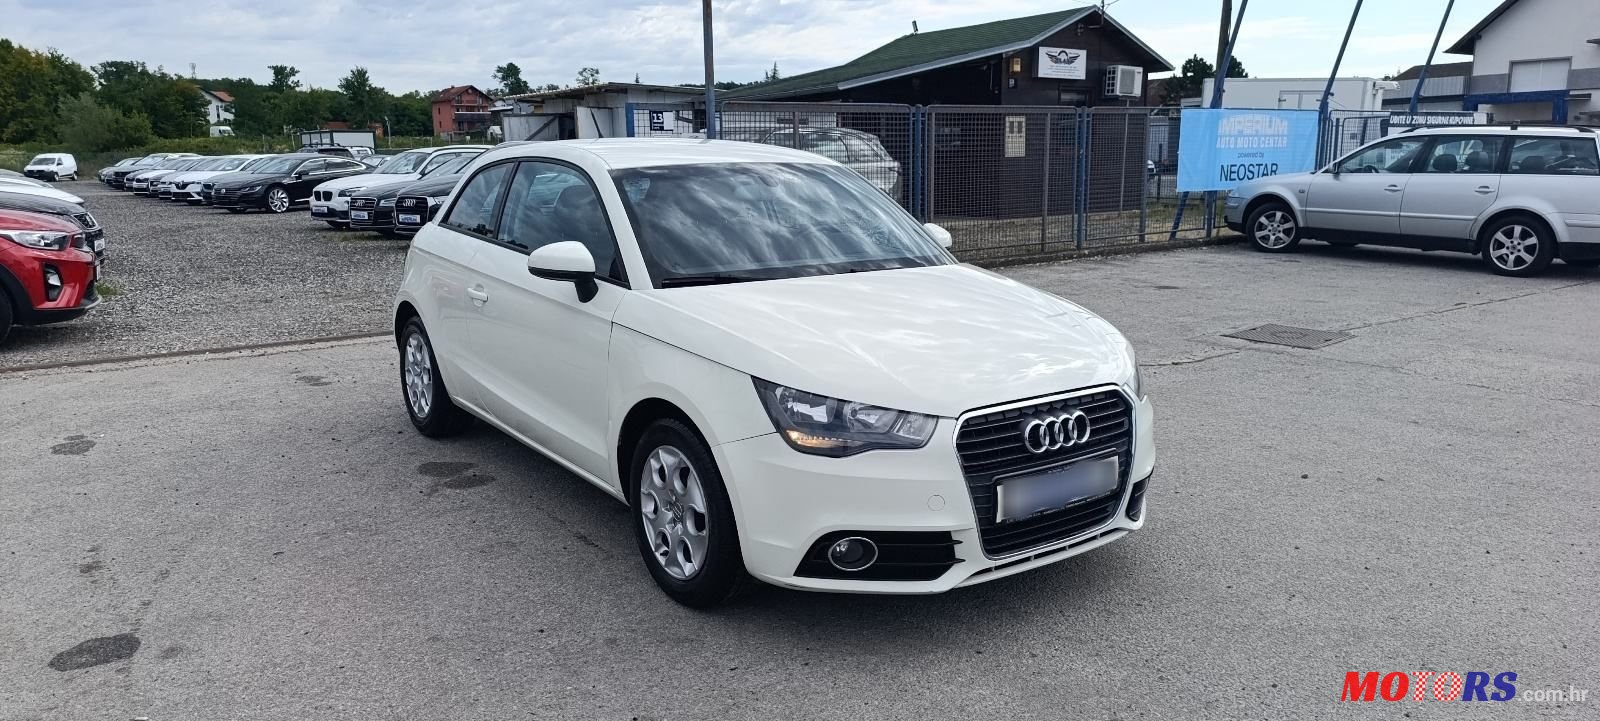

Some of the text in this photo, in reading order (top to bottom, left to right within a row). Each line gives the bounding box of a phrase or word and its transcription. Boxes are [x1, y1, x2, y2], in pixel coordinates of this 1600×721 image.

[652, 113, 664, 123] 13
[1218, 114, 1288, 136] IMPERIUM
[1216, 136, 1288, 149] AUTO MOTO CENTAR
[1219, 162, 1279, 182] NEOSTAR
